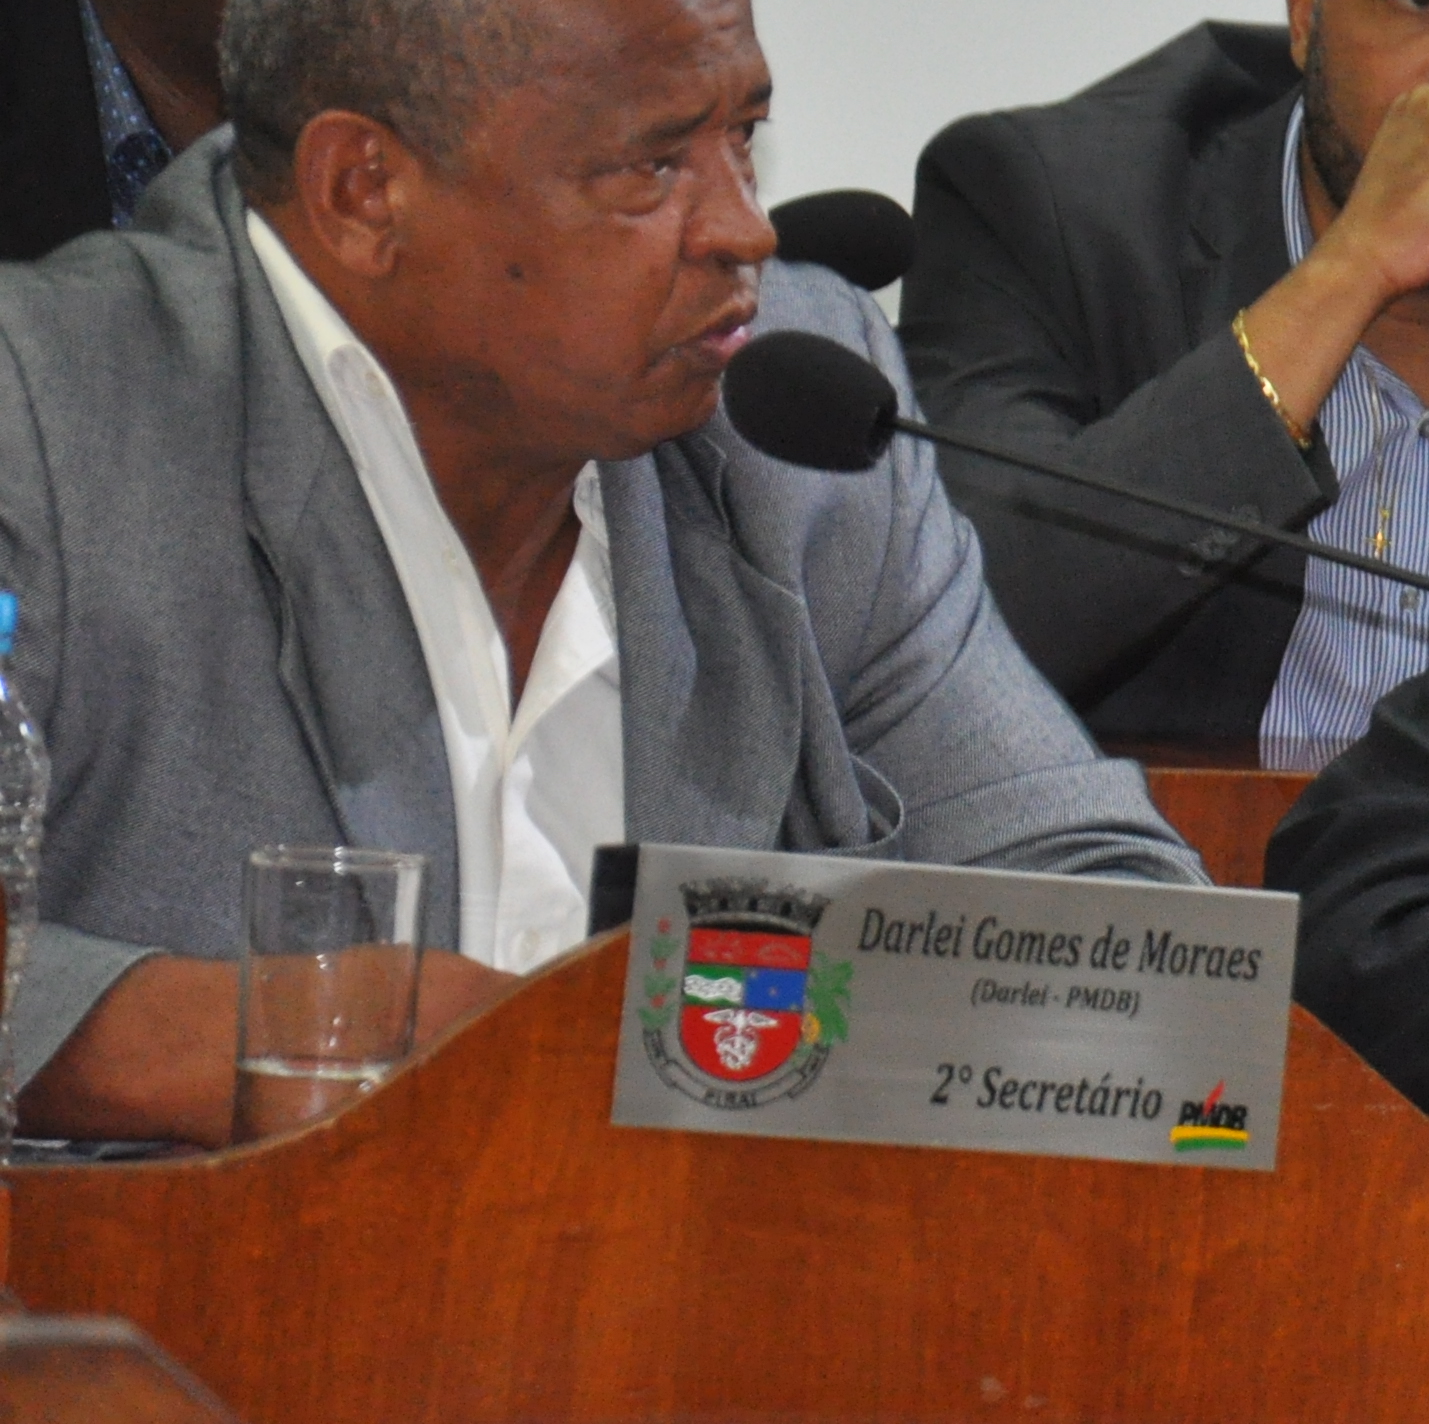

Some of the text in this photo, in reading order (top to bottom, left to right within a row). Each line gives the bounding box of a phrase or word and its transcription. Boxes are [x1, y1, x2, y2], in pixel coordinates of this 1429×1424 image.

[857, 907, 1263, 981] Darlei Gomes de Moraes
[970, 977, 1049, 1008] (Darlei
[1065, 984, 1141, 1018] PMDB)
[976, 1065, 1164, 1121] Secretário
